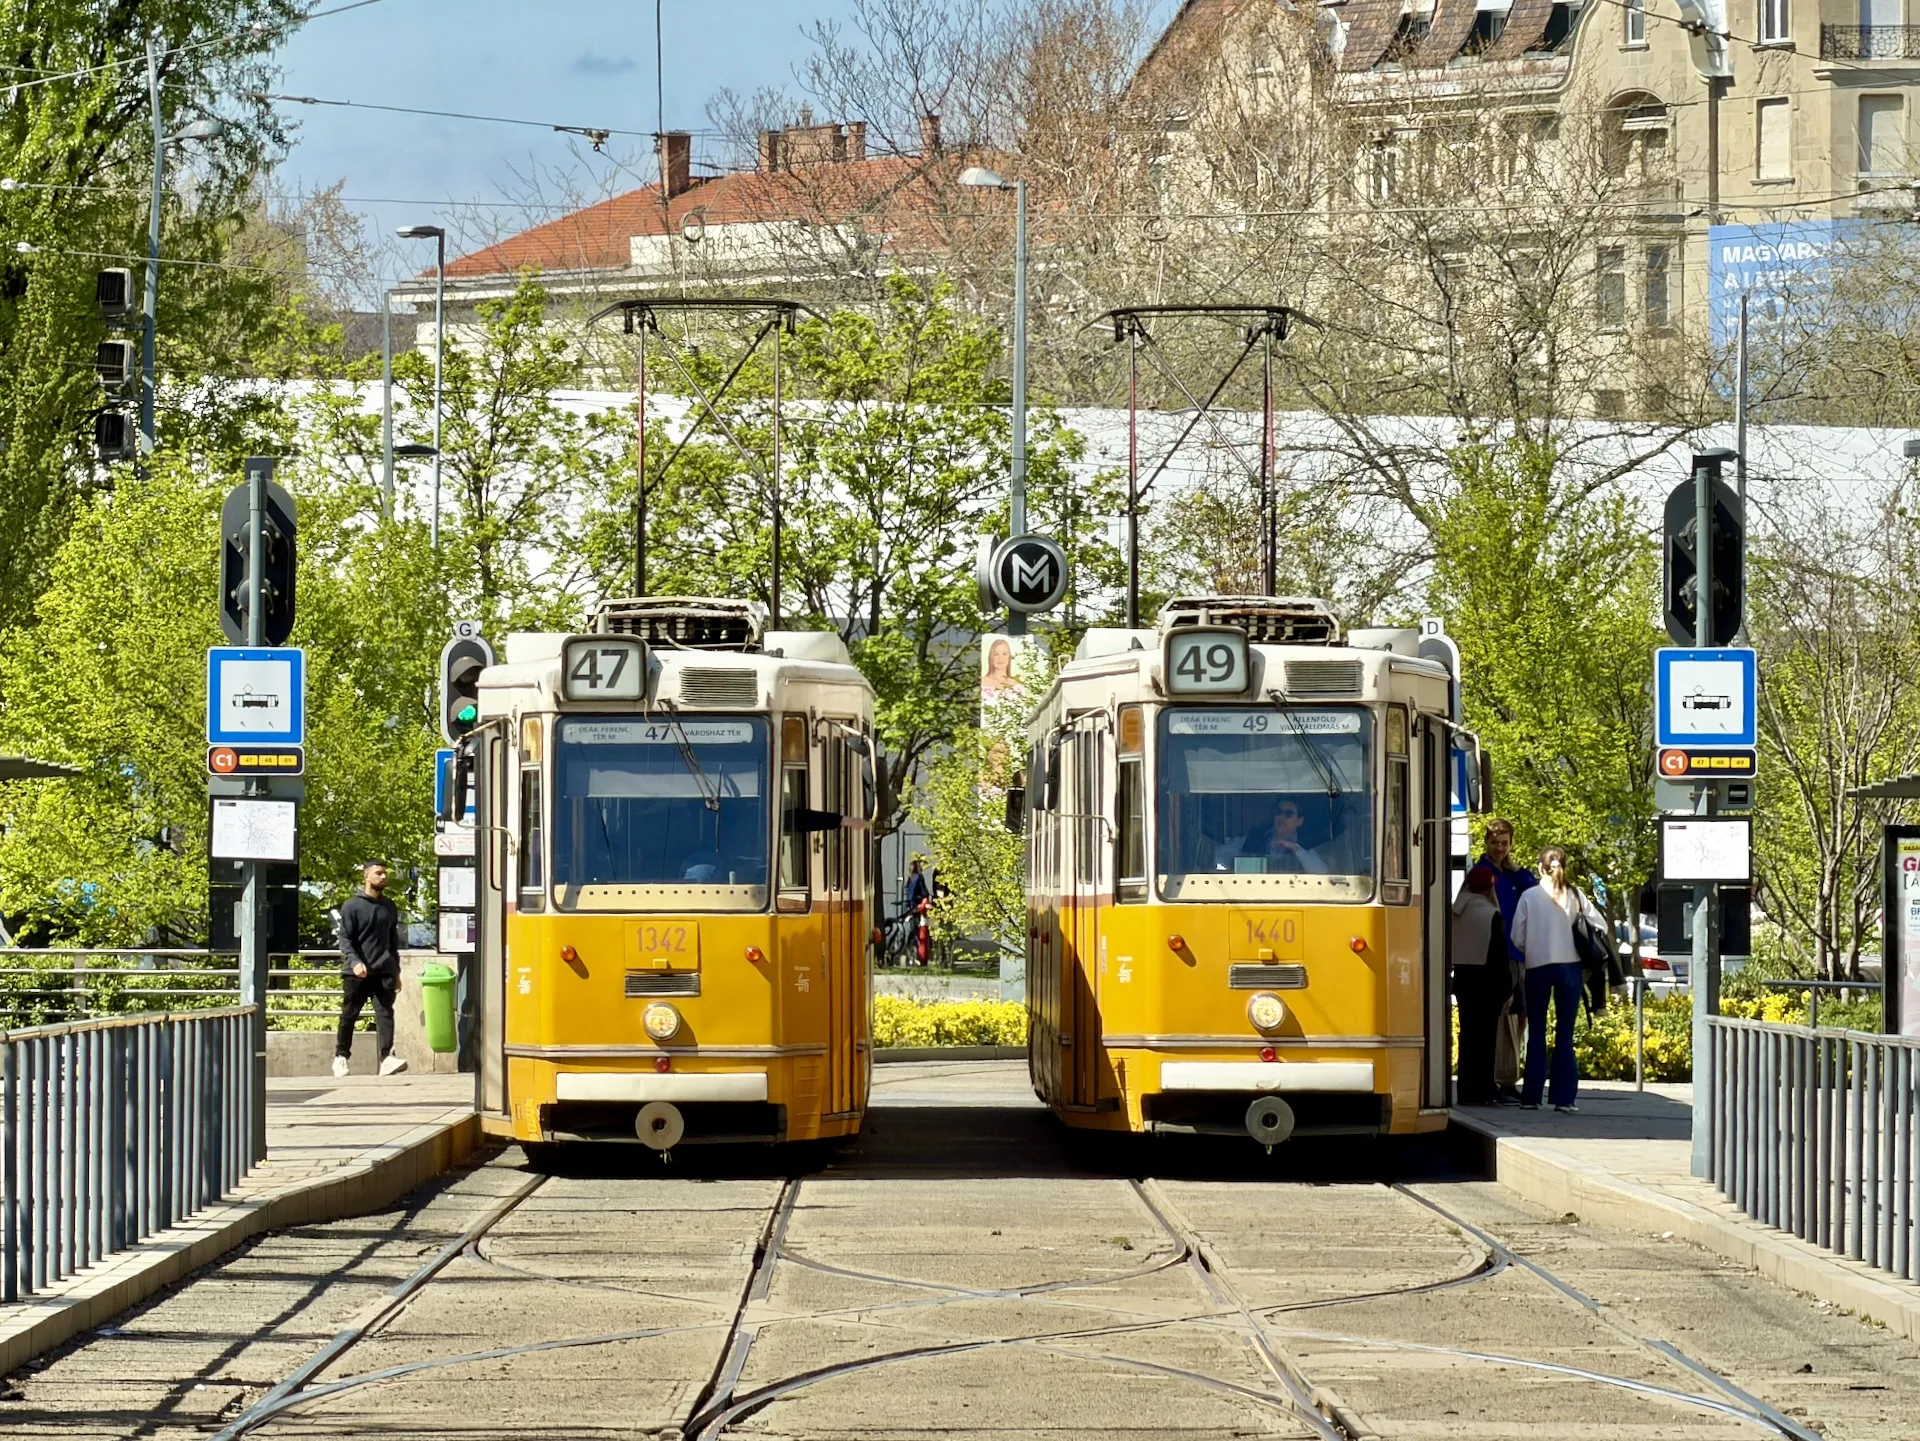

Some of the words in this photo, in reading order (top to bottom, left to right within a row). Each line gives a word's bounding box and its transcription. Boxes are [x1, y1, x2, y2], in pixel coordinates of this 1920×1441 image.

[459, 622, 472, 637] G
[1426, 621, 1439, 635] D
[571, 649, 629, 689] 47
[1176, 644, 1236, 683] 49
[1242, 715, 1269, 732] 49
[644, 725, 672, 741] 47
[215, 754, 233, 767] C1
[1665, 755, 1684, 769] C1
[636, 926, 688, 953] 1342
[1246, 918, 1296, 945] 1440
